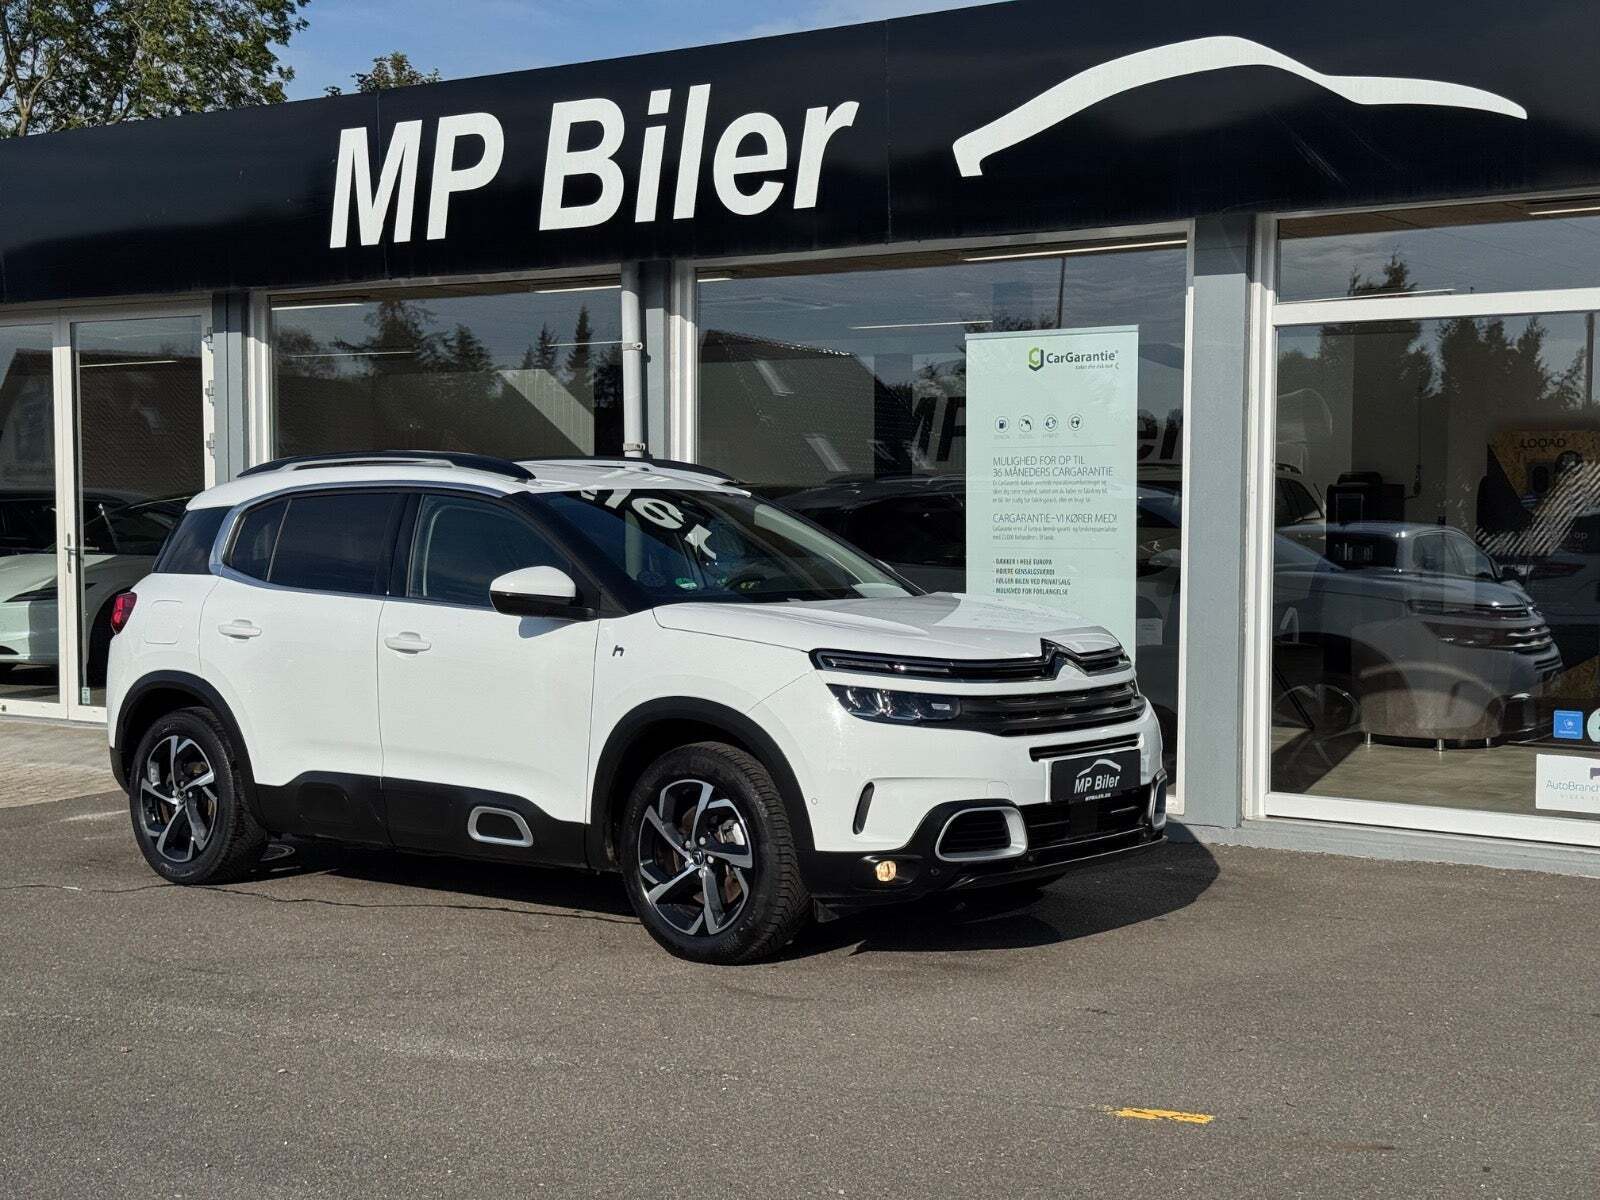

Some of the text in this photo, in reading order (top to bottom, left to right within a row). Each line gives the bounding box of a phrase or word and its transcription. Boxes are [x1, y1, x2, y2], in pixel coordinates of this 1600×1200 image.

[329, 84, 859, 249] MP Biler
[992, 455, 1085, 466] MULIGHED FOR OP TIL
[992, 466, 1113, 478] 36 MÅNEDERS CARGARANTIE
[1066, 513, 1093, 523] KØRER
[1074, 774, 1121, 794] MP Biler
